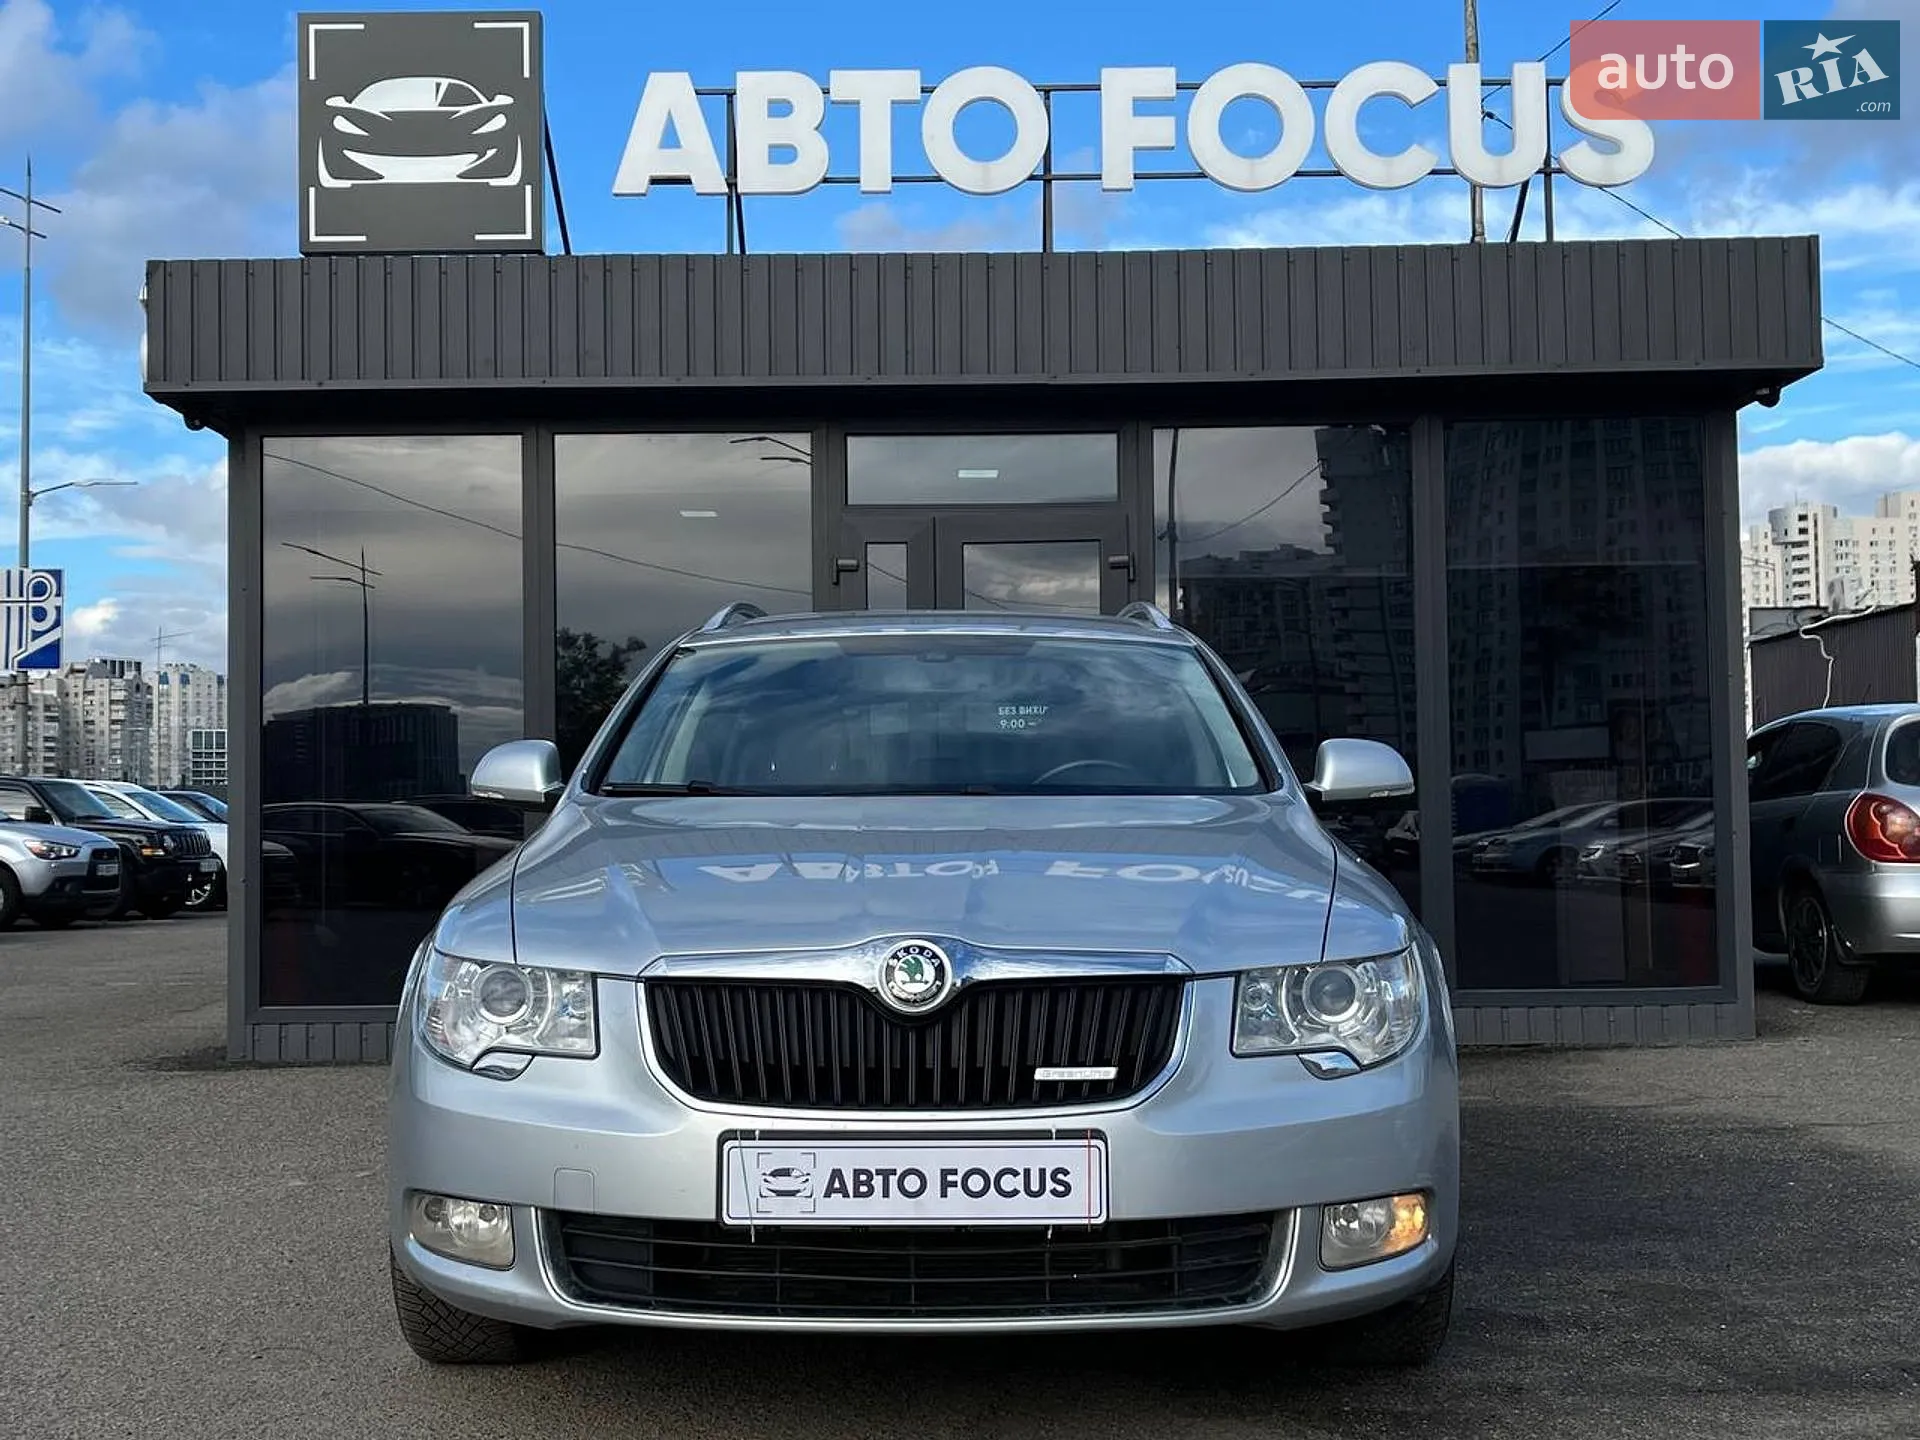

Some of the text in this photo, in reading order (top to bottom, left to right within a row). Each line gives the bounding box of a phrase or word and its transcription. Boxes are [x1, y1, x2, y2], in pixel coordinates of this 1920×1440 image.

[612, 61, 1655, 196] АВТО FOCUS
[822, 1166, 1073, 1199] АВТО FOCUS
